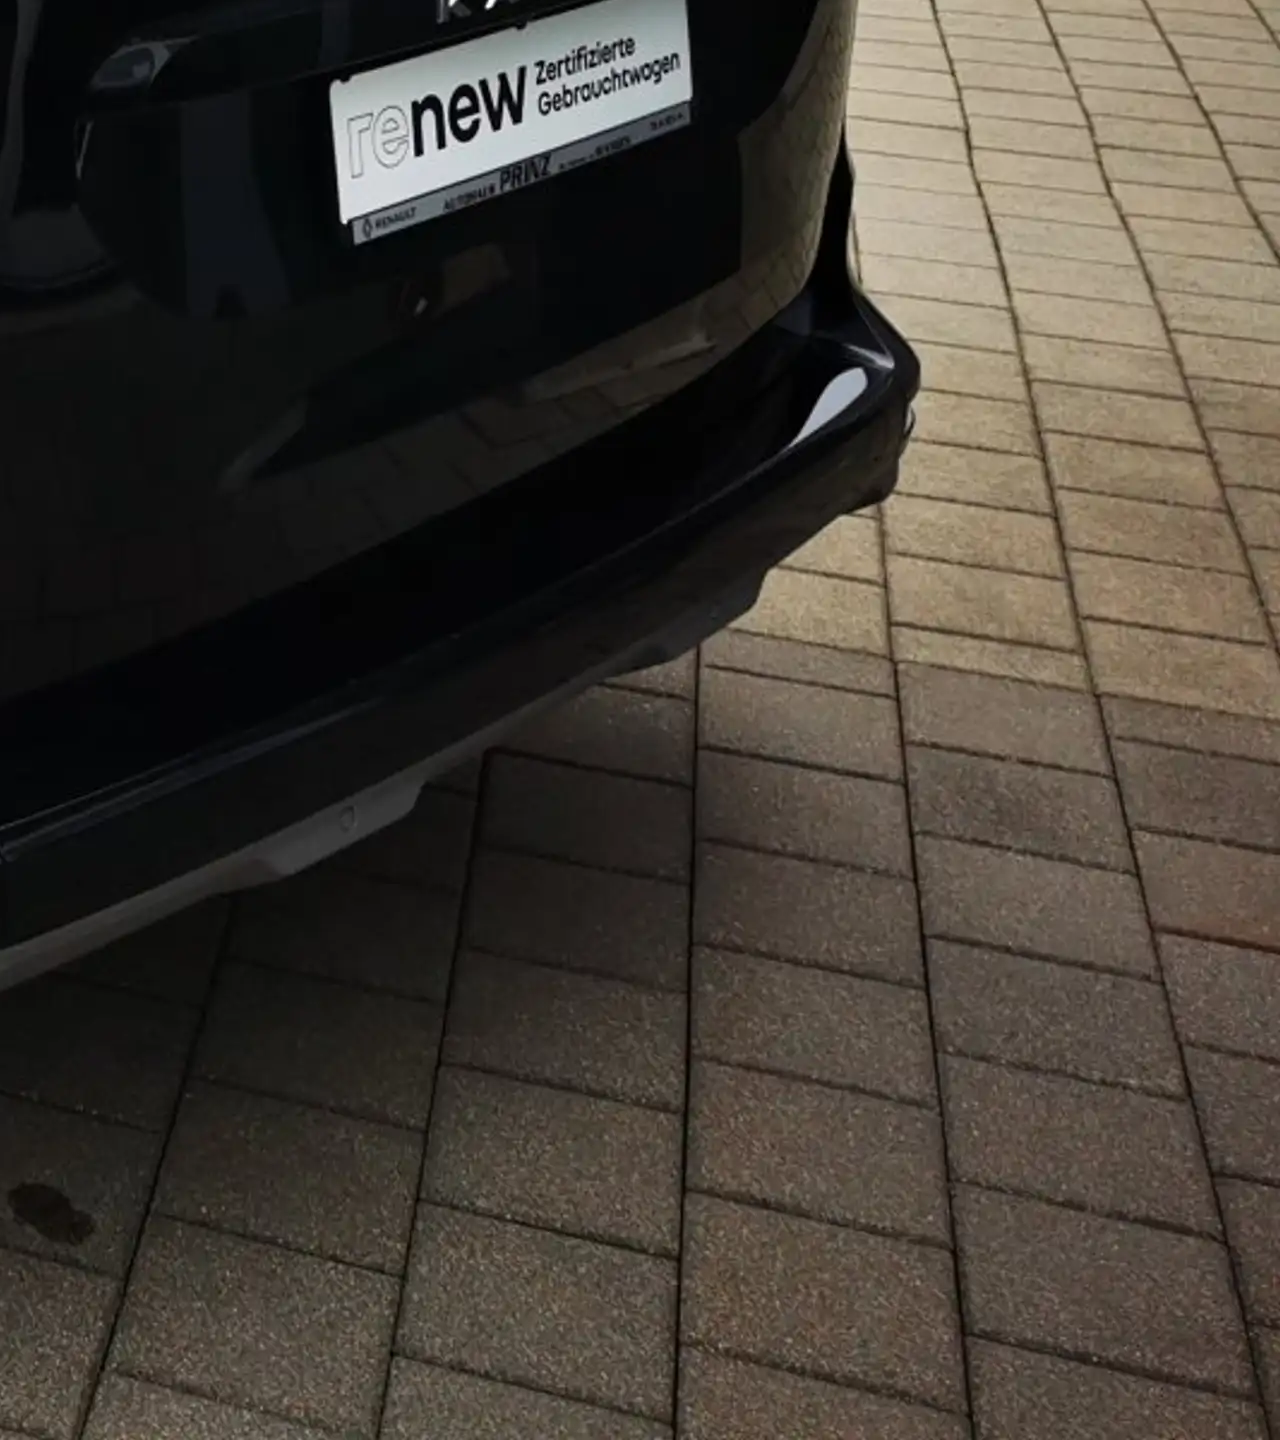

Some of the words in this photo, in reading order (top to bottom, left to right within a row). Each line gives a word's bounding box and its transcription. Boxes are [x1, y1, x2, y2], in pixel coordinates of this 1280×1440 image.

[534, 37, 636, 85] Zertifizierte
[538, 52, 680, 116] Gebrauchtwagen
[347, 65, 527, 179] renew
[499, 153, 552, 192] PRINZ
[375, 206, 417, 229] RENAULT
